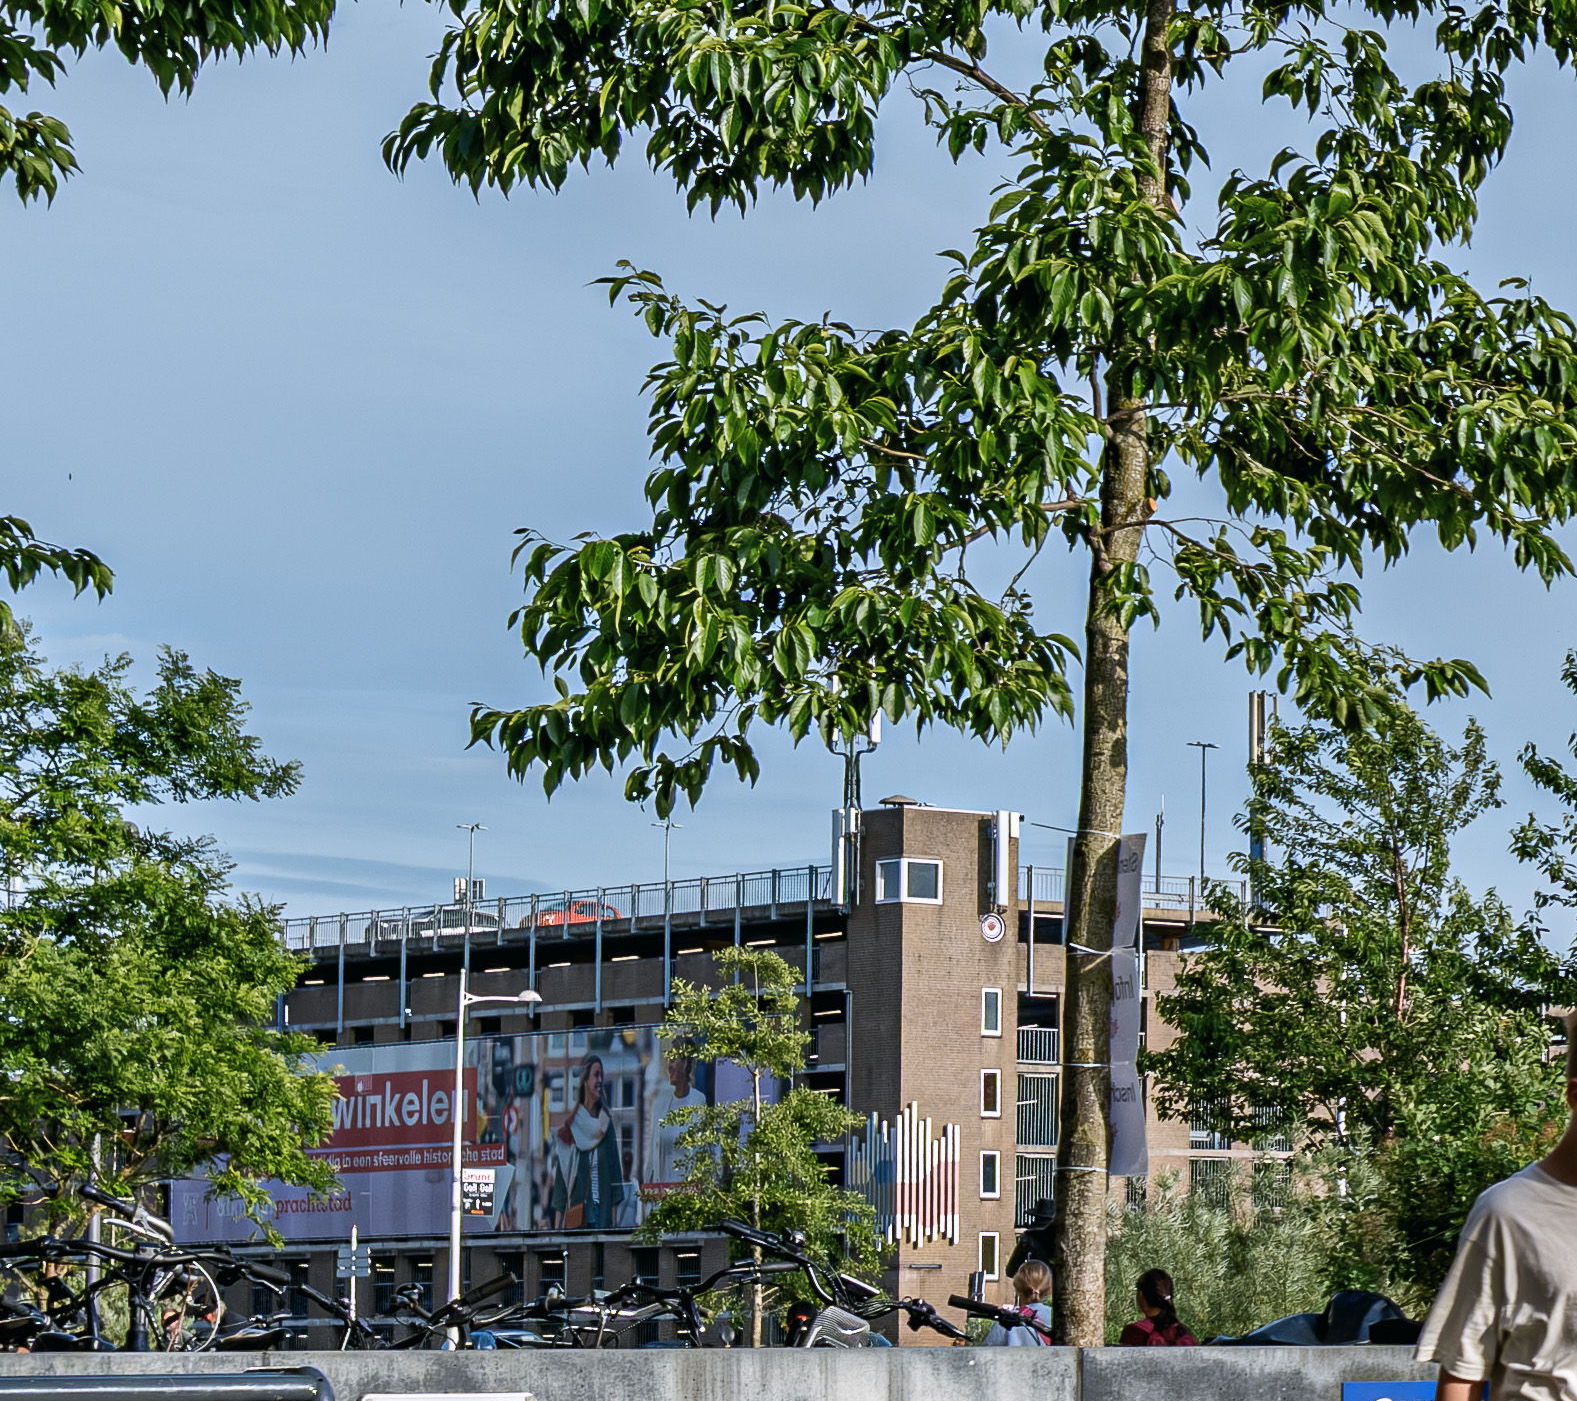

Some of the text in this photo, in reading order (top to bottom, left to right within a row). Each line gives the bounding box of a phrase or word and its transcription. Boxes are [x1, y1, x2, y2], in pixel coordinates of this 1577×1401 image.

[331, 1078, 469, 1130] winkelen
[423, 1146, 478, 1165] historche
[481, 1145, 504, 1161] stad
